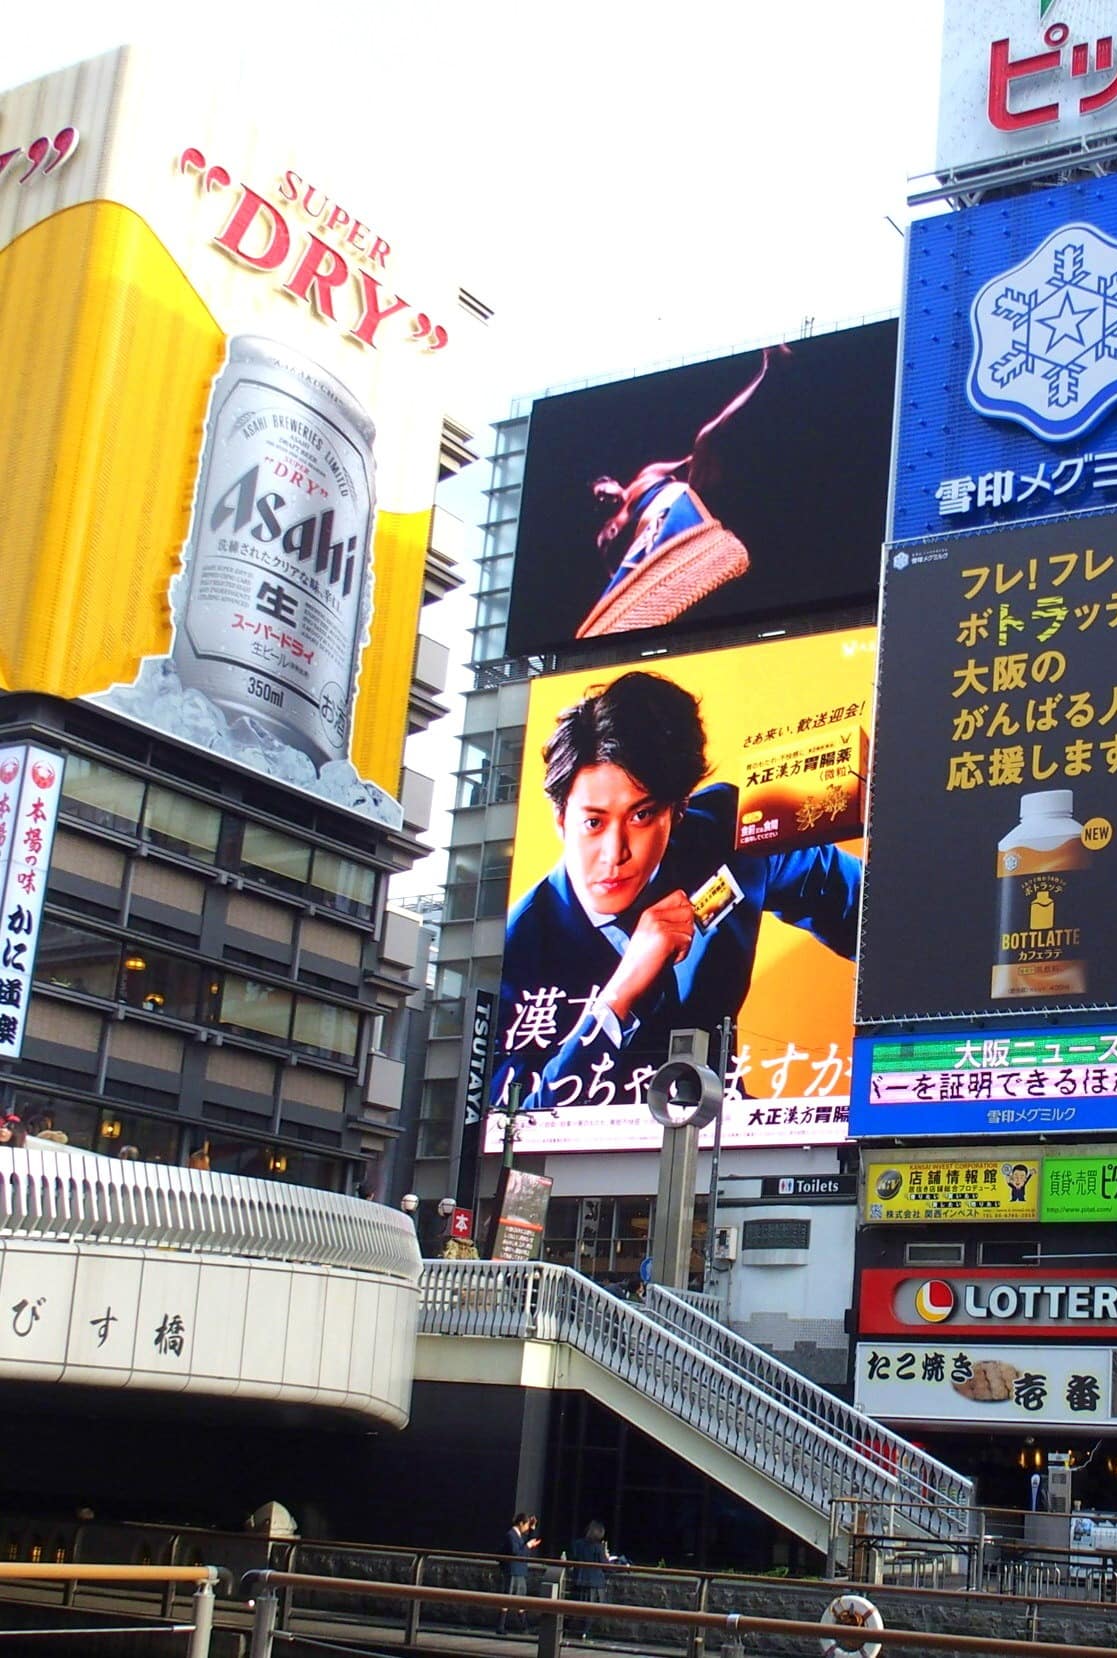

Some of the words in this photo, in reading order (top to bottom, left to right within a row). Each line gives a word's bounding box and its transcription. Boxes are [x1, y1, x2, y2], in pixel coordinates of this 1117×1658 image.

[279, 170, 391, 268] SUPER
[243, 417, 268, 440] ASAHI
[272, 414, 323, 451] BREWERIES
[325, 451, 349, 497] LIMITED
[285, 456, 310, 474] SUPER
[211, 464, 358, 599] Asahi
[256, 581, 298, 629] 生
[231, 613, 314, 665] スーパードライ
[251, 641, 291, 669] 生ビール
[951, 650, 1067, 699] 大阪の
[248, 676, 285, 709] 350ml
[746, 747, 852, 787] 大正漢方胃腸薬
[18, 797, 47, 896] 本場の味
[1085, 827, 1110, 842] NEW
[1024, 882, 1064, 897] ボトラッテ
[1002, 928, 1080, 951] BOTTLATTE
[1018, 950, 1063, 961] カフェラテ
[465, 1003, 491, 1126] TSUTAYA
[986, 1107, 1076, 1124] 雪印メグミルク
[796, 1179, 839, 1194] Toilets
[909, 1168, 997, 1185] 店舗情報館
[455, 1214, 469, 1232] 本
[867, 1351, 974, 1383] たこ焼き
[1013, 1373, 1101, 1412] 壱番
